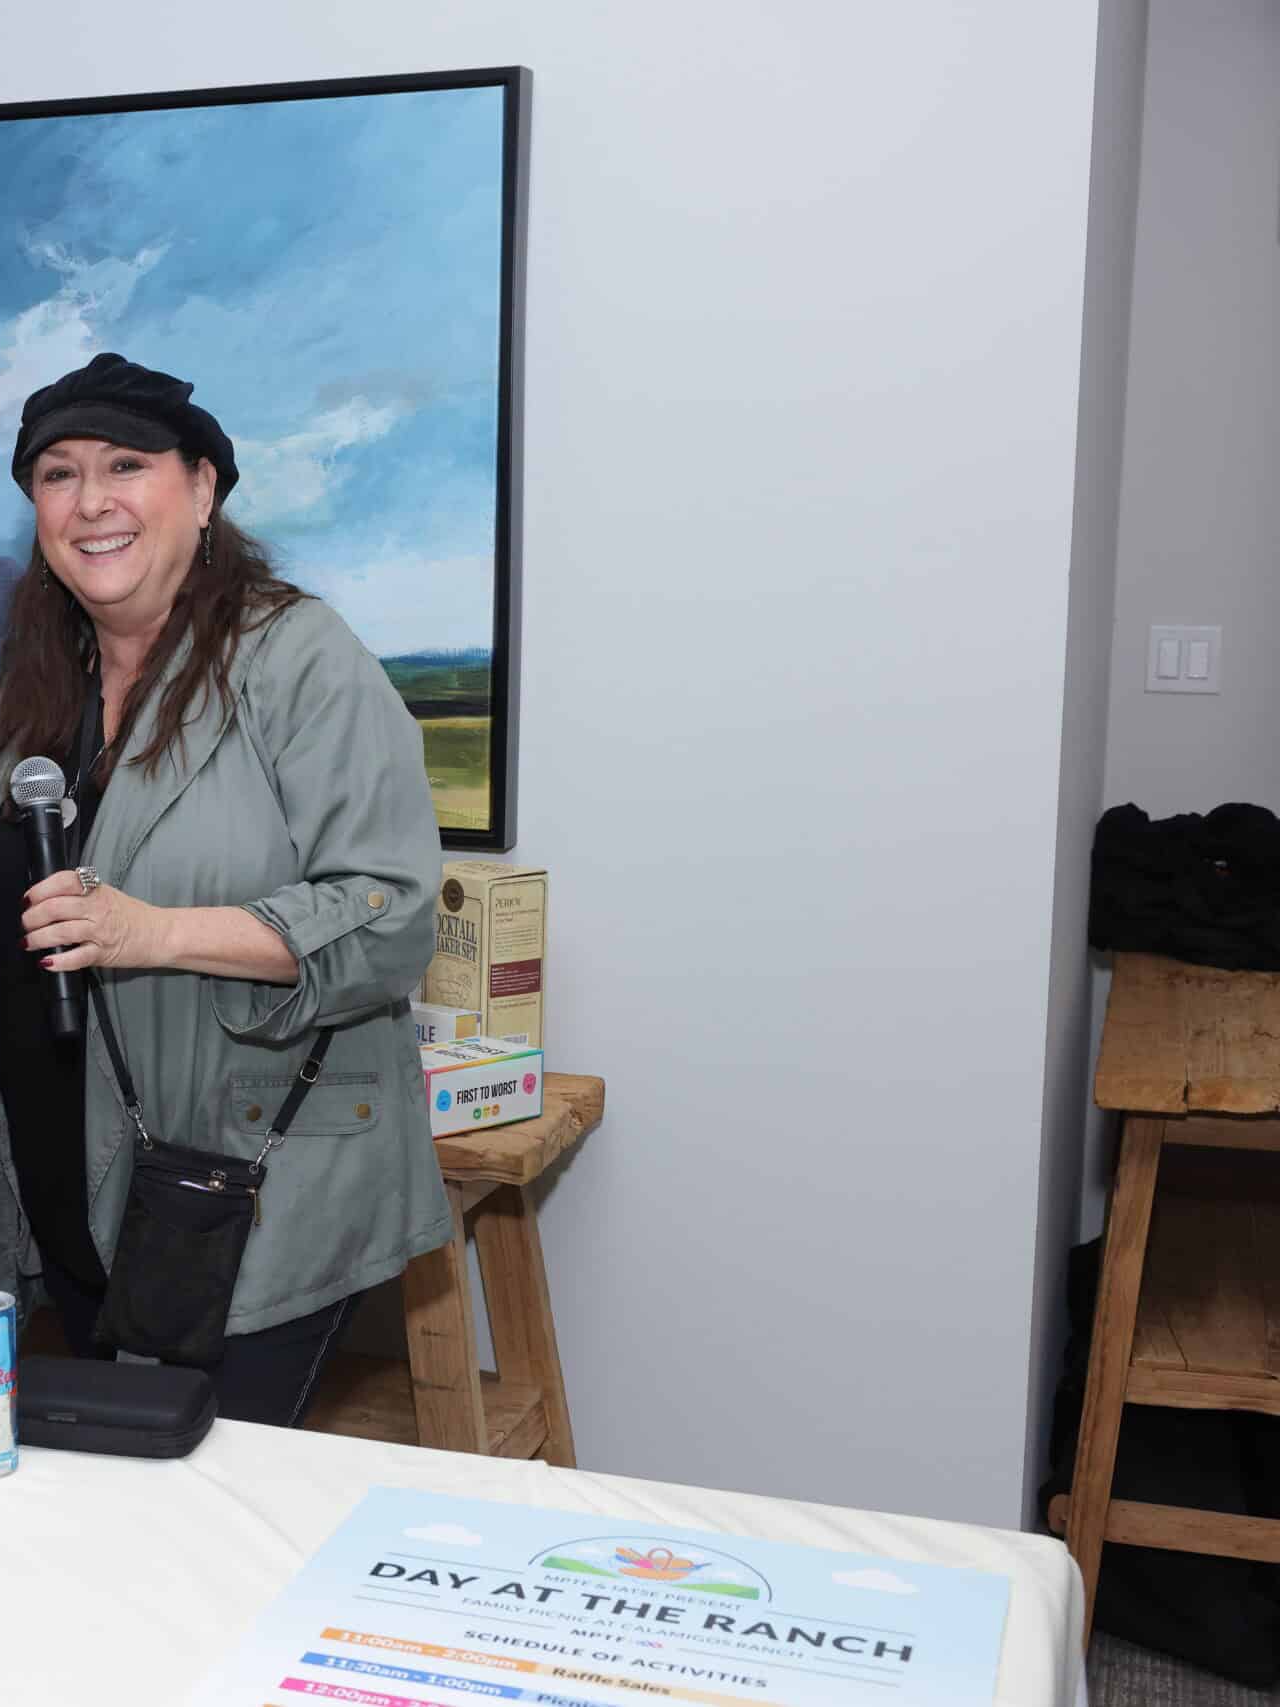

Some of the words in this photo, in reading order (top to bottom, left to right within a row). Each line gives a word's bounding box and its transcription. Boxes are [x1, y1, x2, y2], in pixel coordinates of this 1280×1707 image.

[462, 942, 478, 962] SET
[457, 1087, 479, 1105] FIRST
[480, 1085, 490, 1100] TO
[491, 1080, 518, 1098] WORST
[369, 1561, 480, 1590] DAY
[490, 1581, 564, 1603] AT
[581, 1593, 686, 1625] THE
[702, 1613, 913, 1662] RANCH
[662, 1593, 744, 1612] PRESENT
[461, 1597, 524, 1613] FAMILY
[528, 1607, 592, 1625] PICNIC
[620, 1622, 730, 1647] CALAMIGOS
[734, 1644, 806, 1660] RANCH
[570, 1628, 626, 1643] MPTF
[339, 1631, 423, 1655] 11:00am
[552, 1667, 615, 1686] Raffle
[616, 1678, 671, 1696] Sales
[463, 1630, 585, 1657] SCHEDULE
[590, 1651, 625, 1663] OF
[630, 1658, 768, 1689] ACTIVITIES
[303, 1682, 391, 1706] 12:00pm
[324, 1656, 409, 1680] 11:30am
[426, 1674, 502, 1698] 1:00pm
[537, 1693, 619, 1707] Picni
